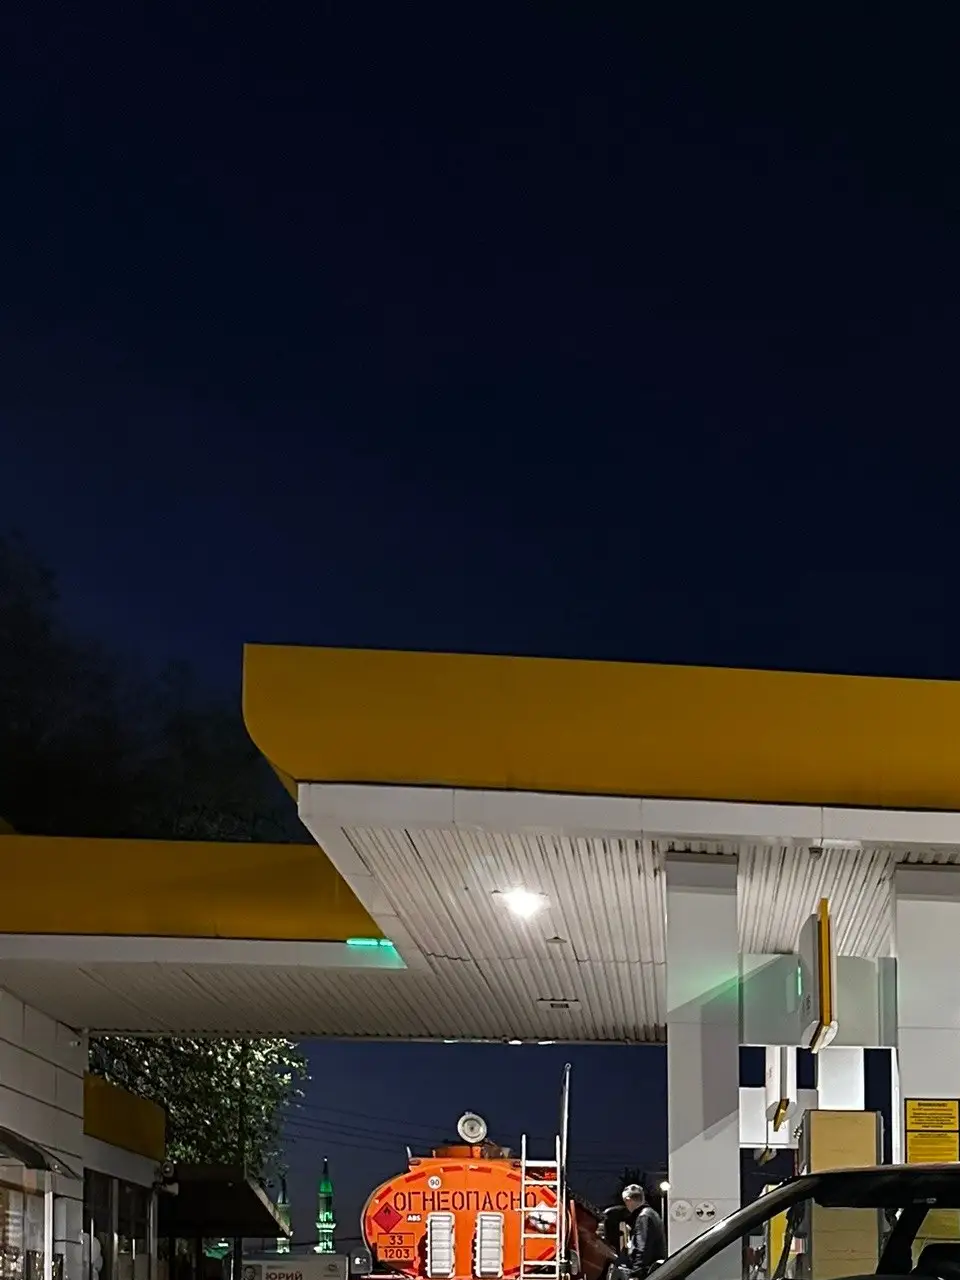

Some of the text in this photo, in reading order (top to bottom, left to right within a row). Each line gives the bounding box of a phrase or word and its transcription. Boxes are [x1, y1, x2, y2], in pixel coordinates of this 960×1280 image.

[430, 1178, 440, 1186] 90
[393, 1191, 537, 1211] ОГНЕОПАСНО
[407, 1214, 422, 1222] ABS
[389, 1234, 404, 1246] 33
[384, 1248, 410, 1259] 1203
[265, 1270, 303, 1280] ЮРИЙ
